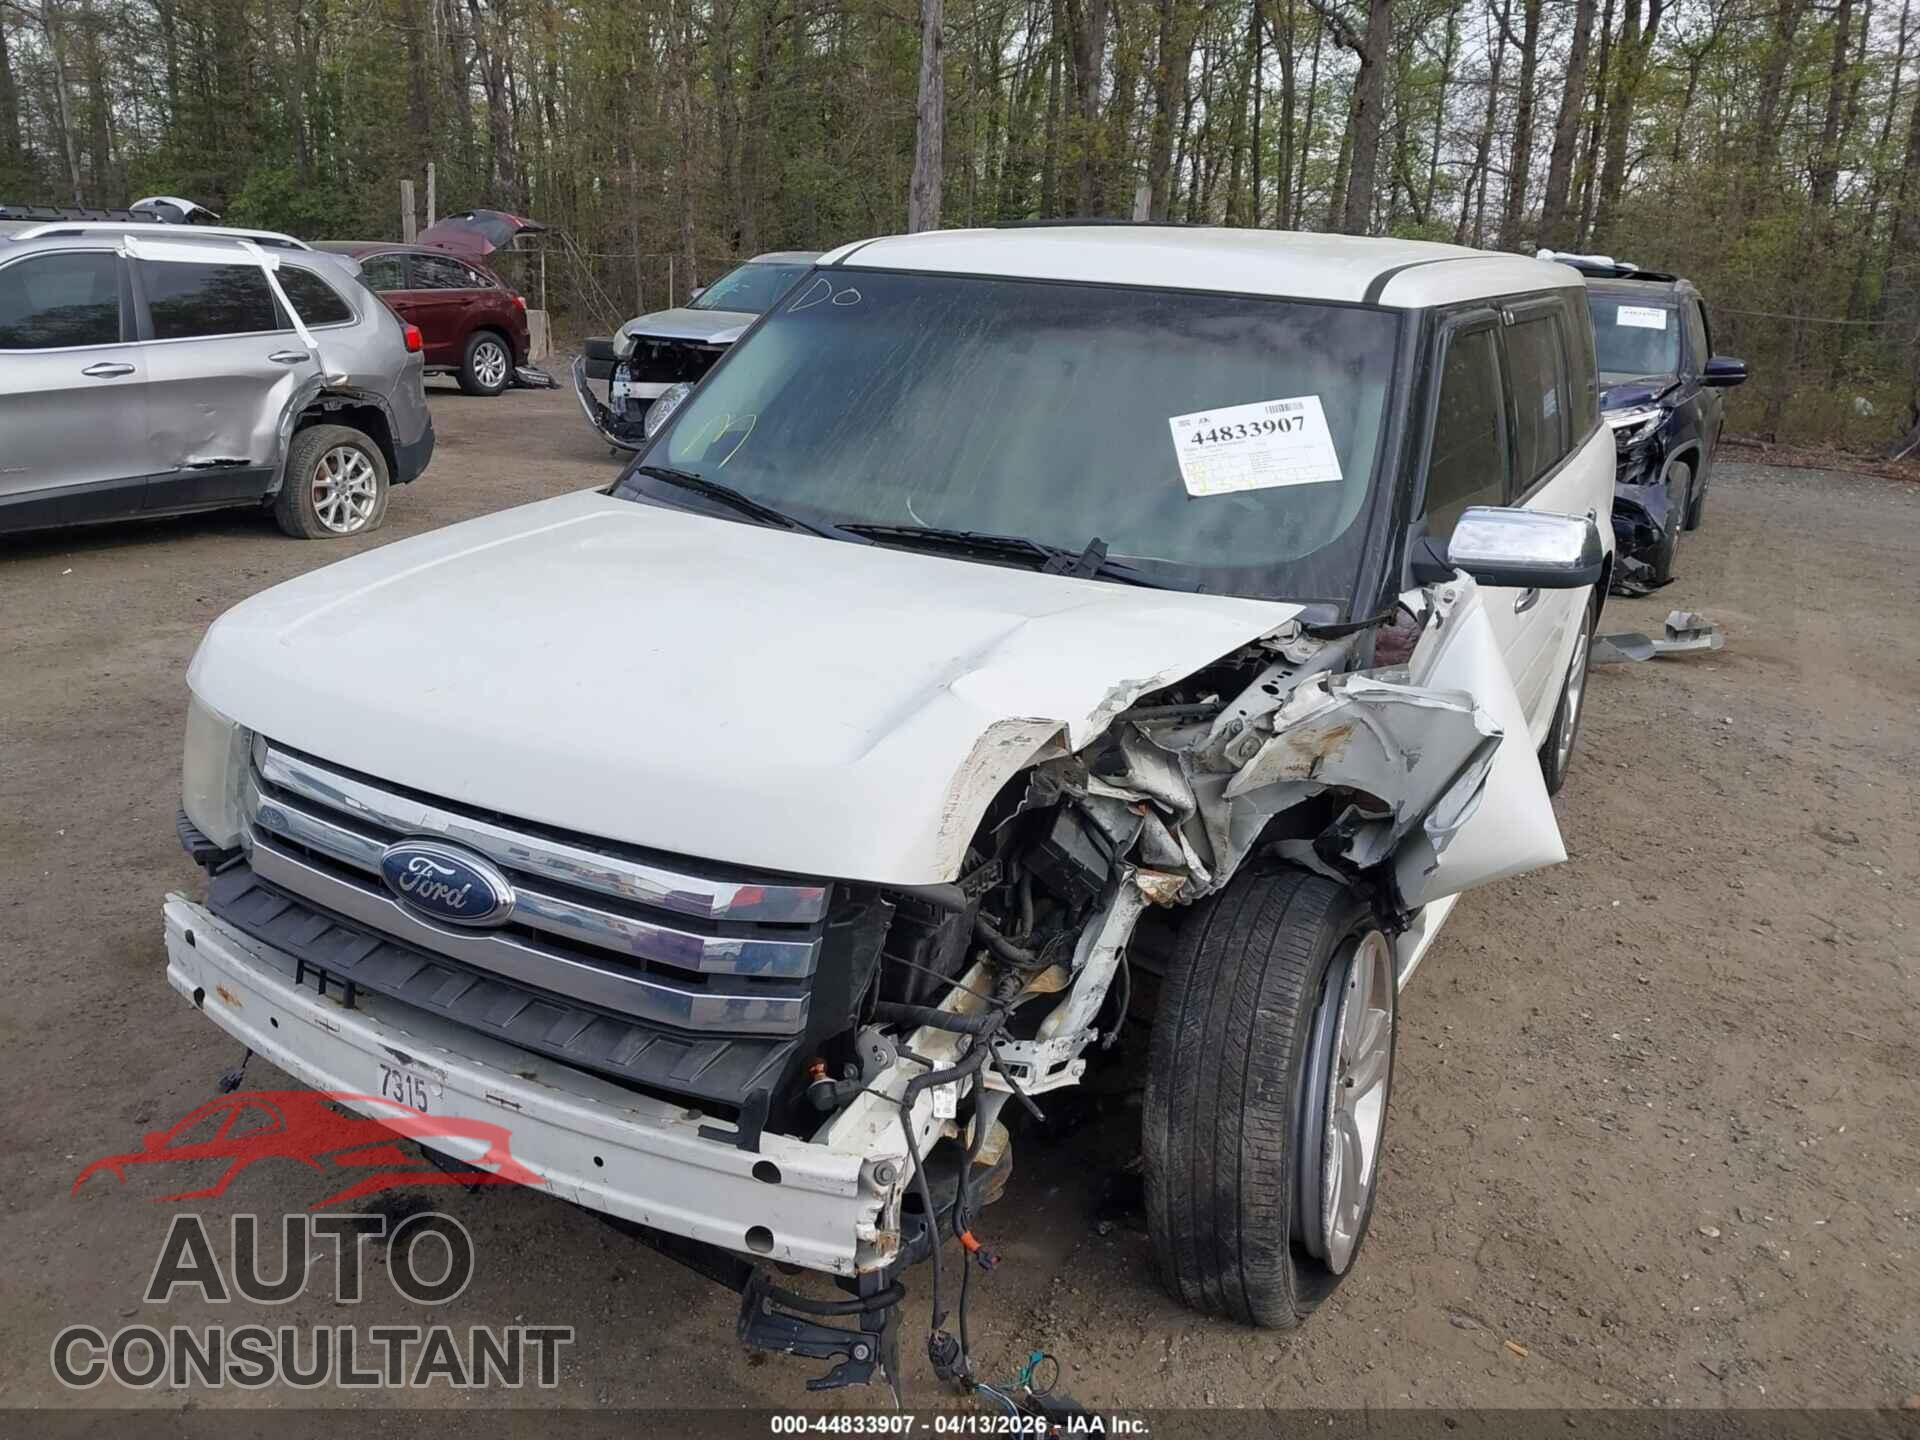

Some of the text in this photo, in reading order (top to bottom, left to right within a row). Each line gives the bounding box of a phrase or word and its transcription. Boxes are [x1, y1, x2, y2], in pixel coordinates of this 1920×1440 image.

[1191, 415, 1305, 446] 44833907
[399, 857, 473, 909] Ford
[379, 1063, 428, 1113] 7315
